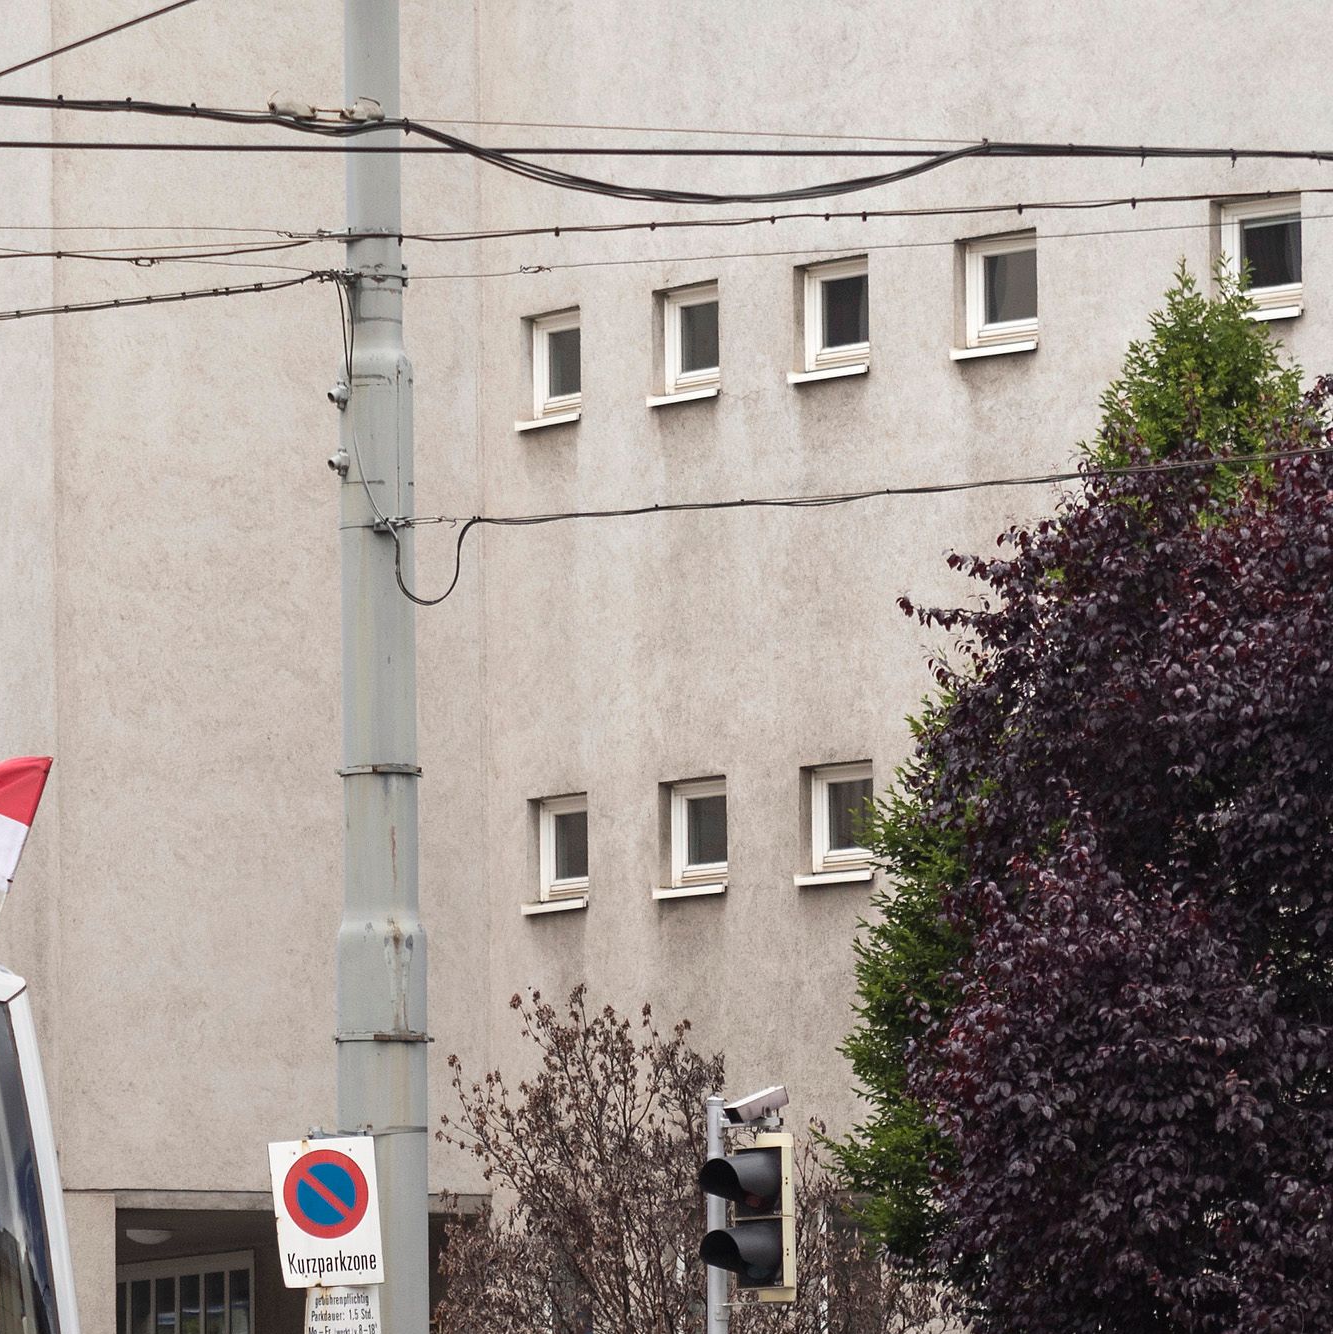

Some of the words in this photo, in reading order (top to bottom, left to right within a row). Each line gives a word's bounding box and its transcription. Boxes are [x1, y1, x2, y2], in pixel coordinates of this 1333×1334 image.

[287, 1249, 377, 1278] Kurzparkzone
[315, 1292, 369, 1308] gebührenpflichtig
[311, 1309, 345, 1321] Parkdauer:
[360, 1308, 374, 1320] Std.
